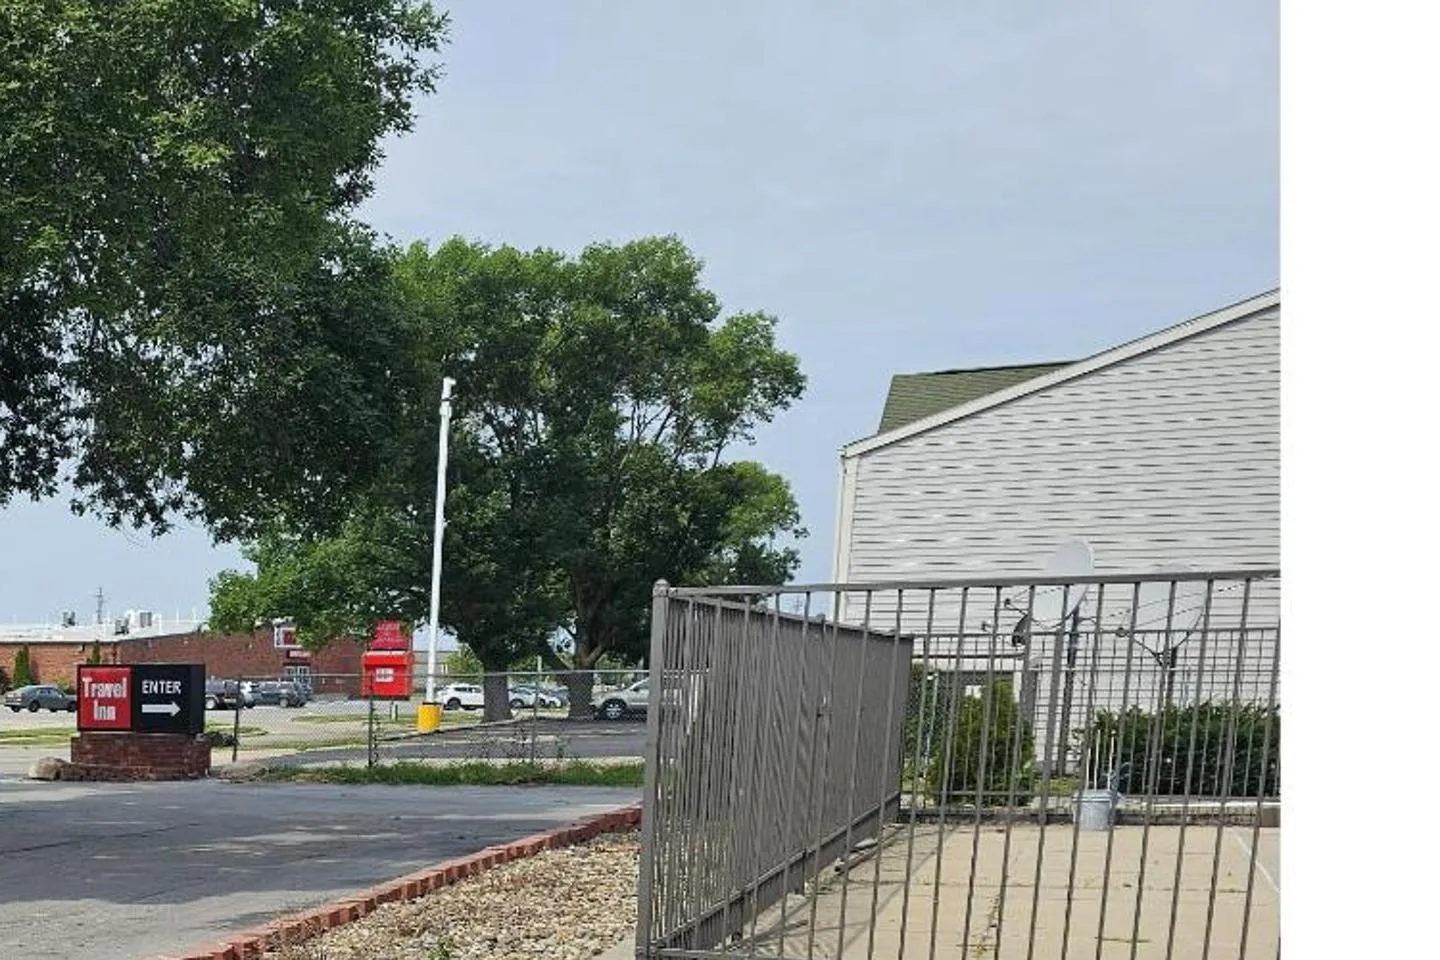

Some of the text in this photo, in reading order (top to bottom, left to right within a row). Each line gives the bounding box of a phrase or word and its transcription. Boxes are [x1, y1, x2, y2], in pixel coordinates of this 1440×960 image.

[82, 677, 127, 698] Travel
[141, 680, 182, 694] ENTER
[93, 699, 116, 720] Inn
